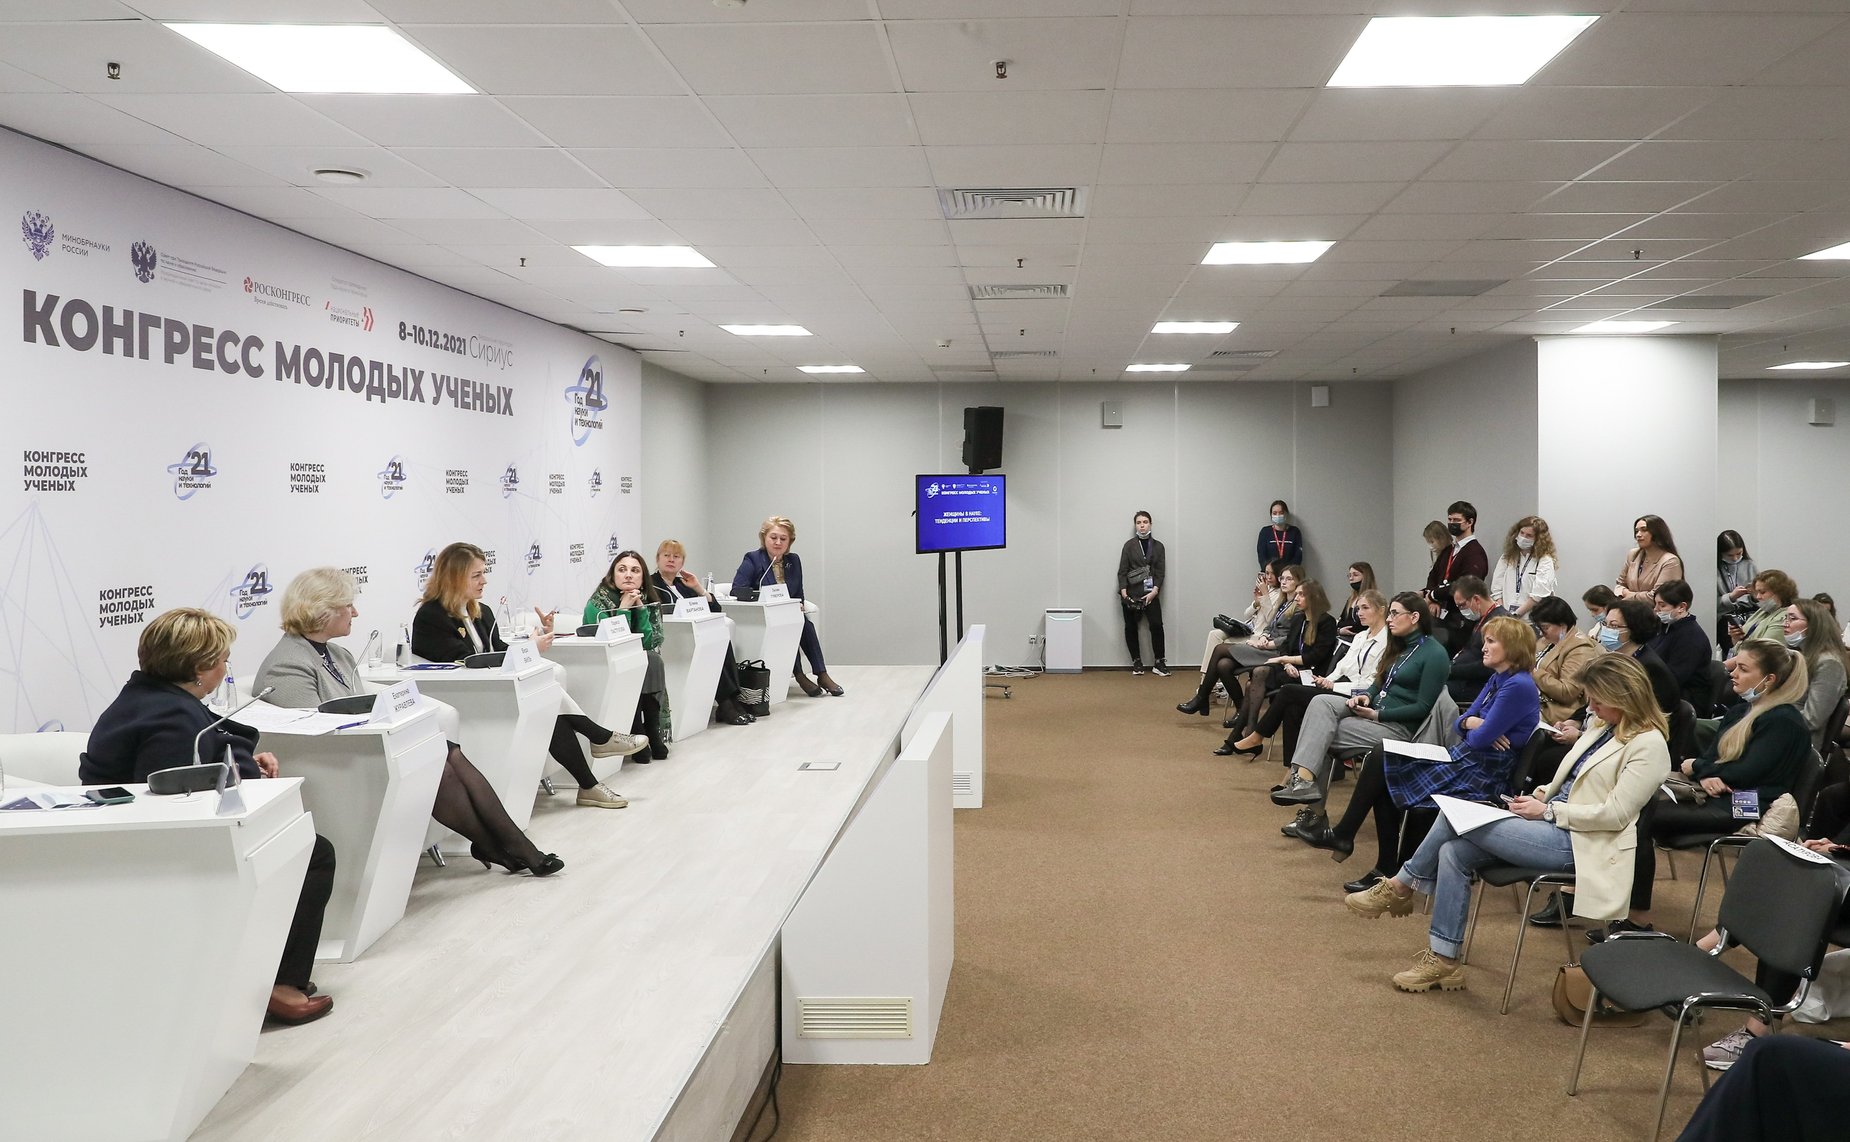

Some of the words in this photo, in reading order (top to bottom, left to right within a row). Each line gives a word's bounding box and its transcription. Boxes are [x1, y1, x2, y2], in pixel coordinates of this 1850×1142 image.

[62, 233, 110, 252] МИНОБРНАУКИ
[62, 244, 88, 256] РОССИИ
[254, 281, 311, 307] РОСКОНГРЕСС
[330, 313, 359, 328] ПРИОРИТЕТЫ
[23, 289, 265, 379] КОНГРЕСС
[275, 340, 425, 403] МОЛОДЫХ
[431, 373, 514, 417] УЧЕНЫХ
[469, 335, 513, 370] Сириус
[575, 393, 584, 407] Год
[23, 450, 86, 464] КОНГРЕСС
[24, 465, 88, 479] МОЛОДЫХ
[179, 467, 188, 475] Год
[290, 462, 325, 472] КОНГРЕСС
[445, 469, 468, 477] КОНГРЕСС
[24, 479, 76, 491] УЧЕНЫХ
[290, 473, 326, 484] МОЛОДЫХ
[445, 478, 469, 486] МОЛОДЫХ
[290, 484, 319, 493] УЧЕНЫХ
[445, 486, 465, 494] УЧЕНЫХ
[99, 585, 153, 601] КОНГРЕСС
[99, 598, 155, 614] МОЛОДЫХ
[99, 612, 144, 628] УЧЕНЫХ
